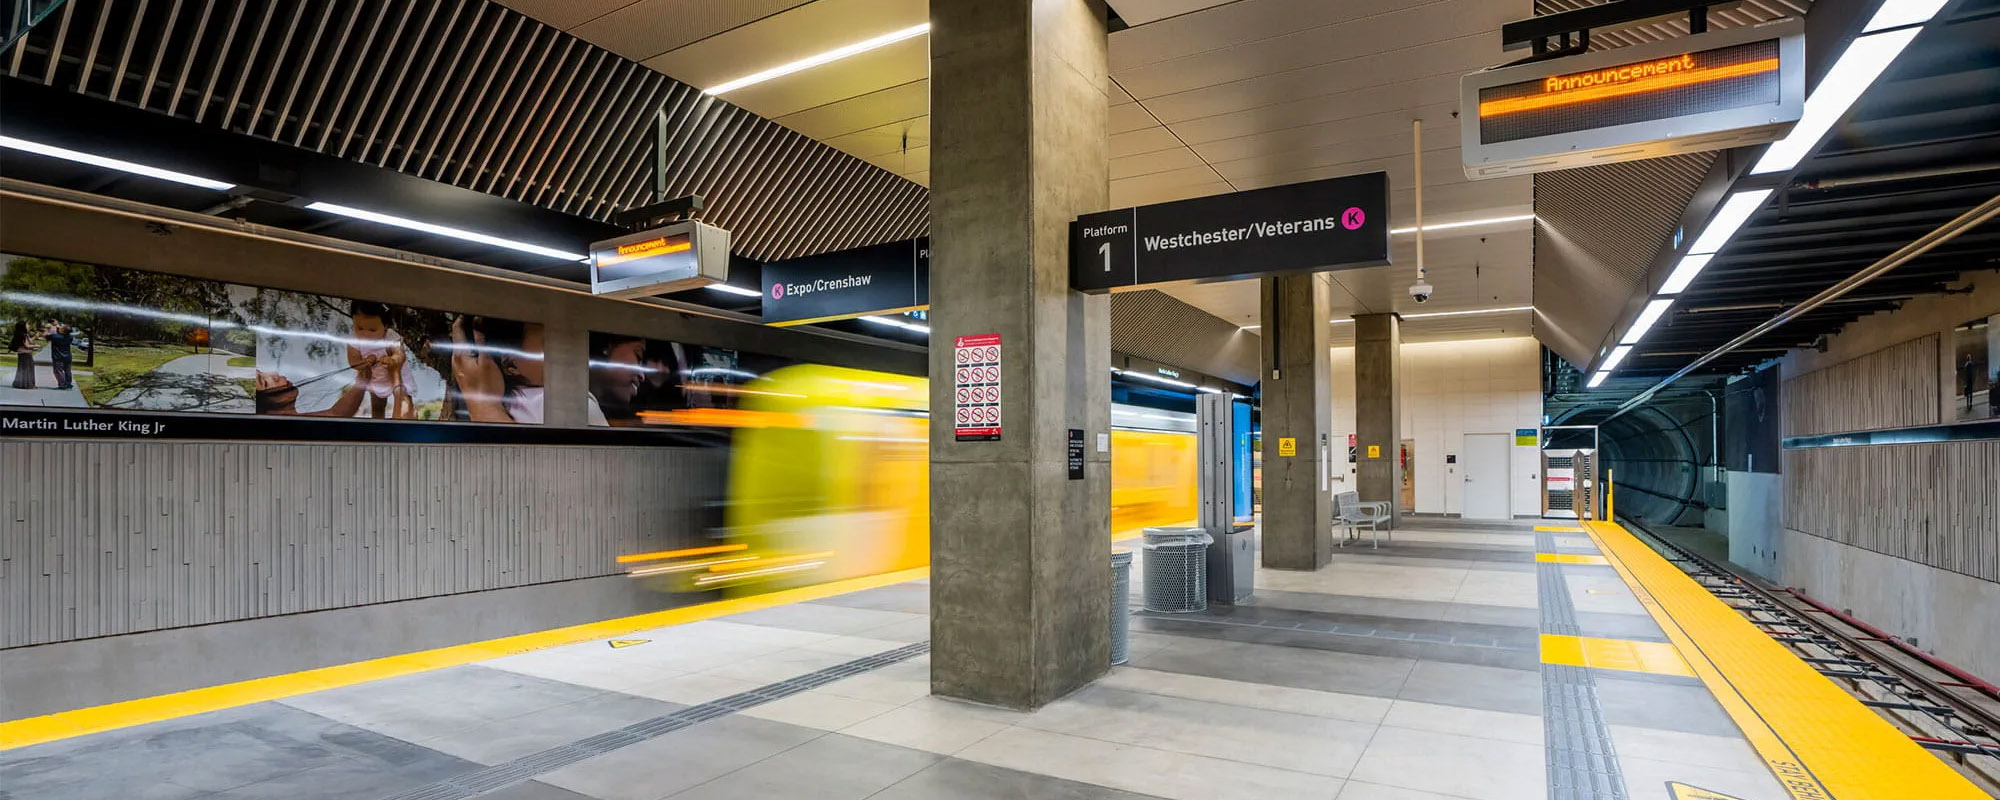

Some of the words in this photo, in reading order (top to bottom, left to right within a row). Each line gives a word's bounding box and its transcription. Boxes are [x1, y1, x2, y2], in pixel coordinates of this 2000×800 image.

[1546, 54, 1695, 92] Announcement
[1083, 223, 1128, 239] Platform
[1144, 215, 1335, 252] Westchester/Veterans
[1348, 211, 1360, 226] K
[1098, 242, 1111, 272] 1
[786, 274, 872, 297] Expo/Crenshaw
[2, 417, 57, 430] Martin
[63, 419, 113, 431] Luther
[118, 420, 150, 435] King
[154, 421, 165, 434] Jr
[1771, 760, 1809, 781] STAY
